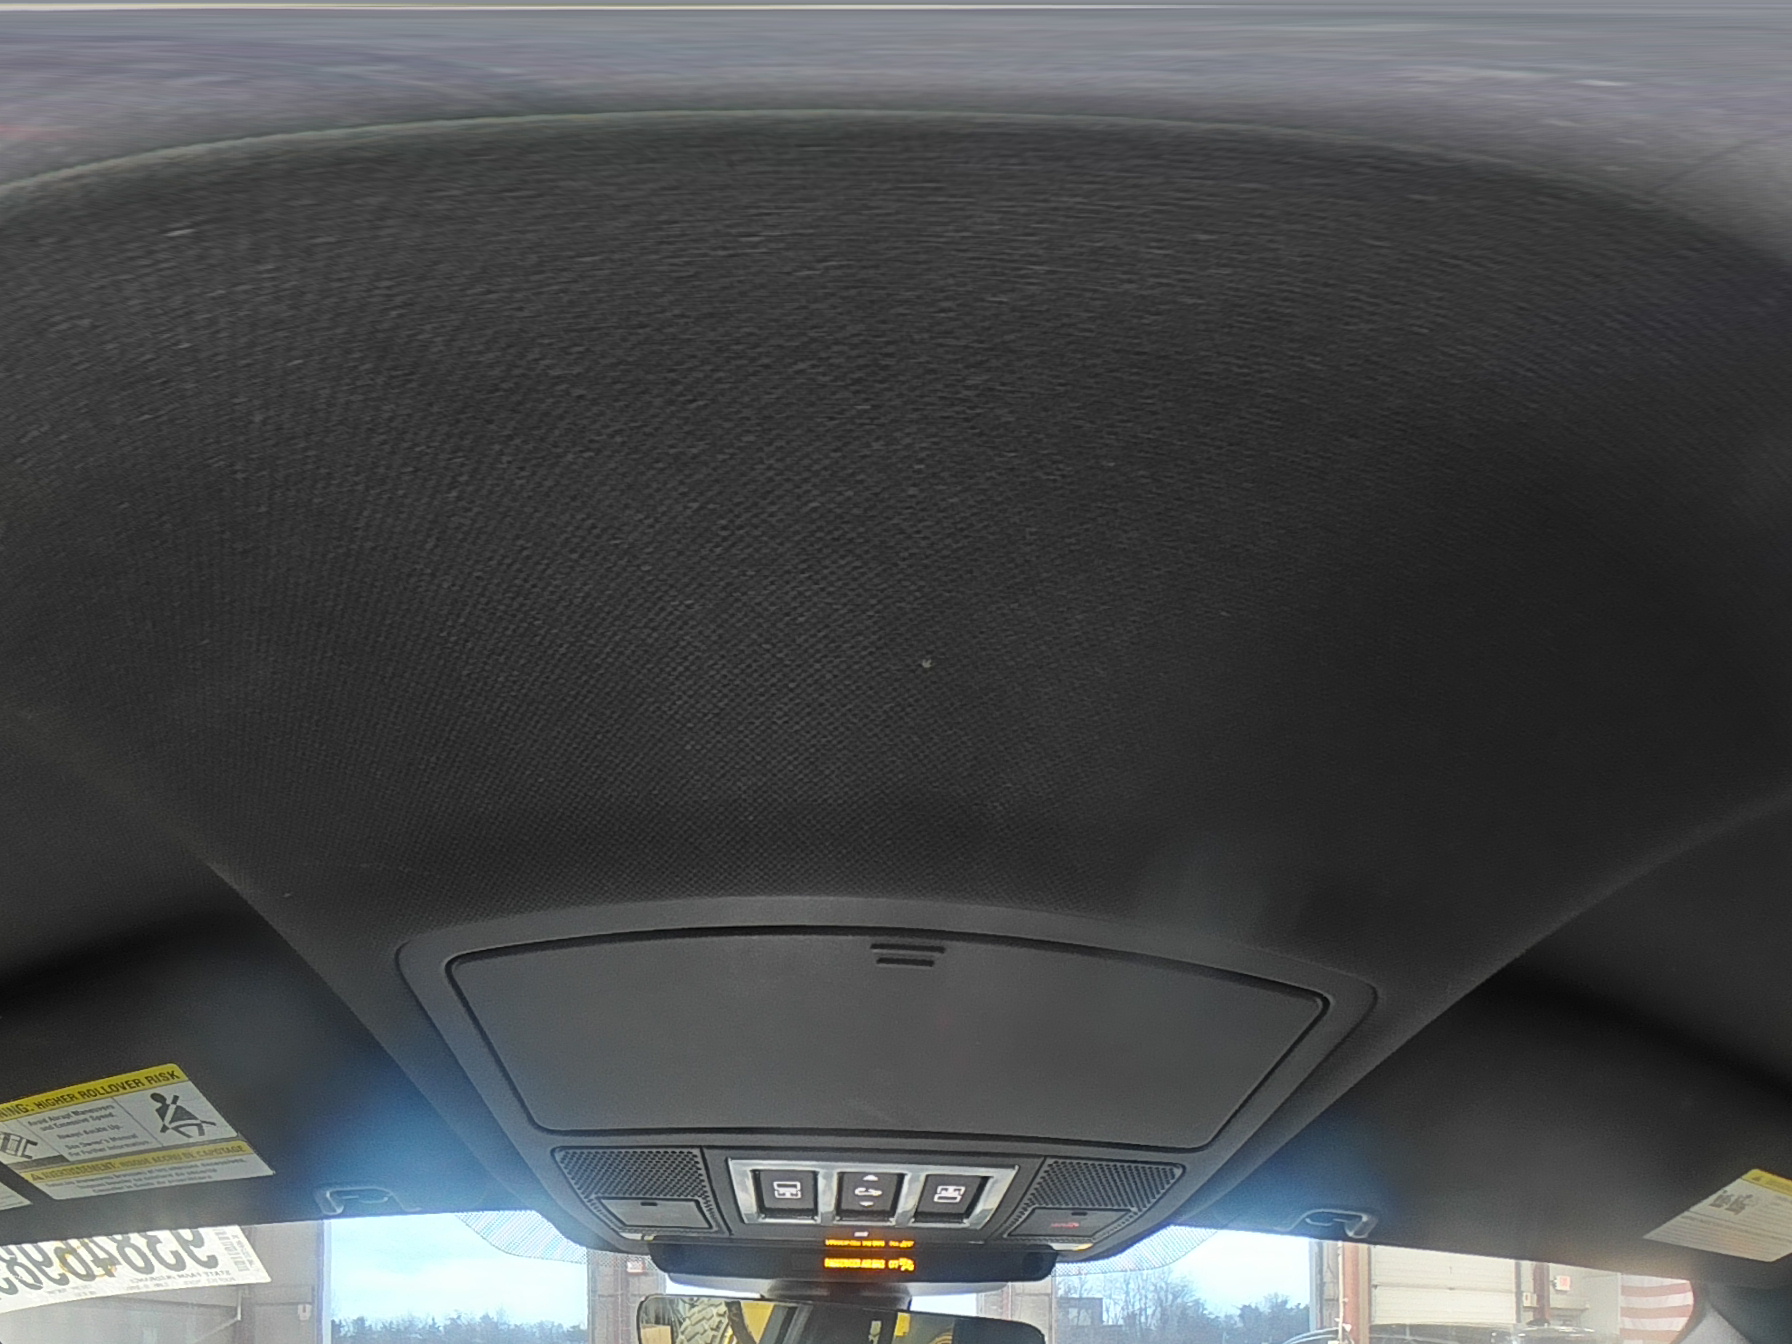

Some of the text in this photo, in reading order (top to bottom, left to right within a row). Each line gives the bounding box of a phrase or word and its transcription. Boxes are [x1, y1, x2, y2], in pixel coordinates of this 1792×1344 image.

[36, 1093, 78, 1110] HIGHER
[77, 1078, 143, 1101] ROLLOVER
[144, 1070, 181, 1085] RISK
